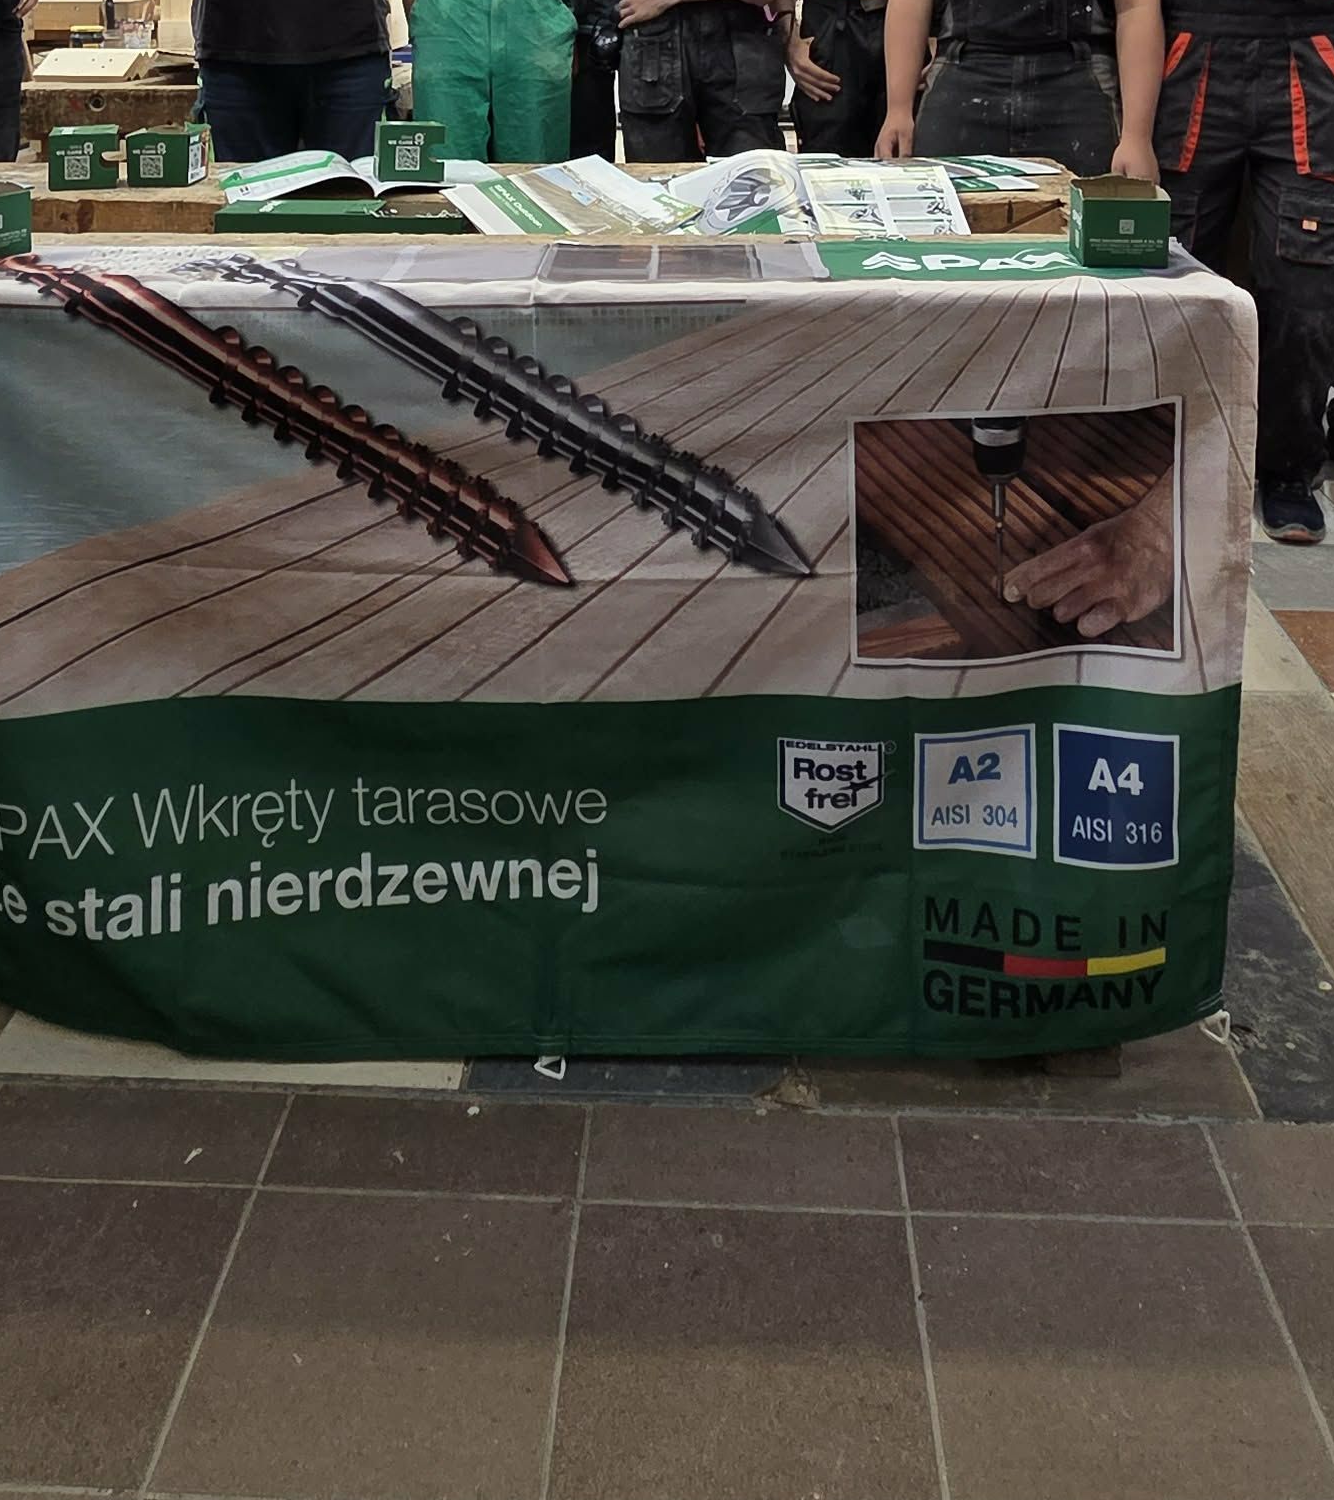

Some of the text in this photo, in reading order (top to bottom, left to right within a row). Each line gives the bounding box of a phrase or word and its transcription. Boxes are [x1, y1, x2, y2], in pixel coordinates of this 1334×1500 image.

[785, 740, 878, 752] EDELSTAHL
[793, 757, 867, 782] Rost
[947, 751, 1002, 786] A2
[1087, 757, 1145, 797] A4
[132, 778, 336, 850] Wkręty
[351, 776, 609, 828] tarasowe
[804, 783, 859, 809] frei
[930, 804, 1019, 829] AISI 304
[1071, 814, 1164, 845] AISI 316
[45, 873, 182, 941] stali
[207, 848, 601, 926] nierdzewnej
[924, 897, 1167, 952] MADE IN
[923, 968, 1166, 1019] GERMANY
